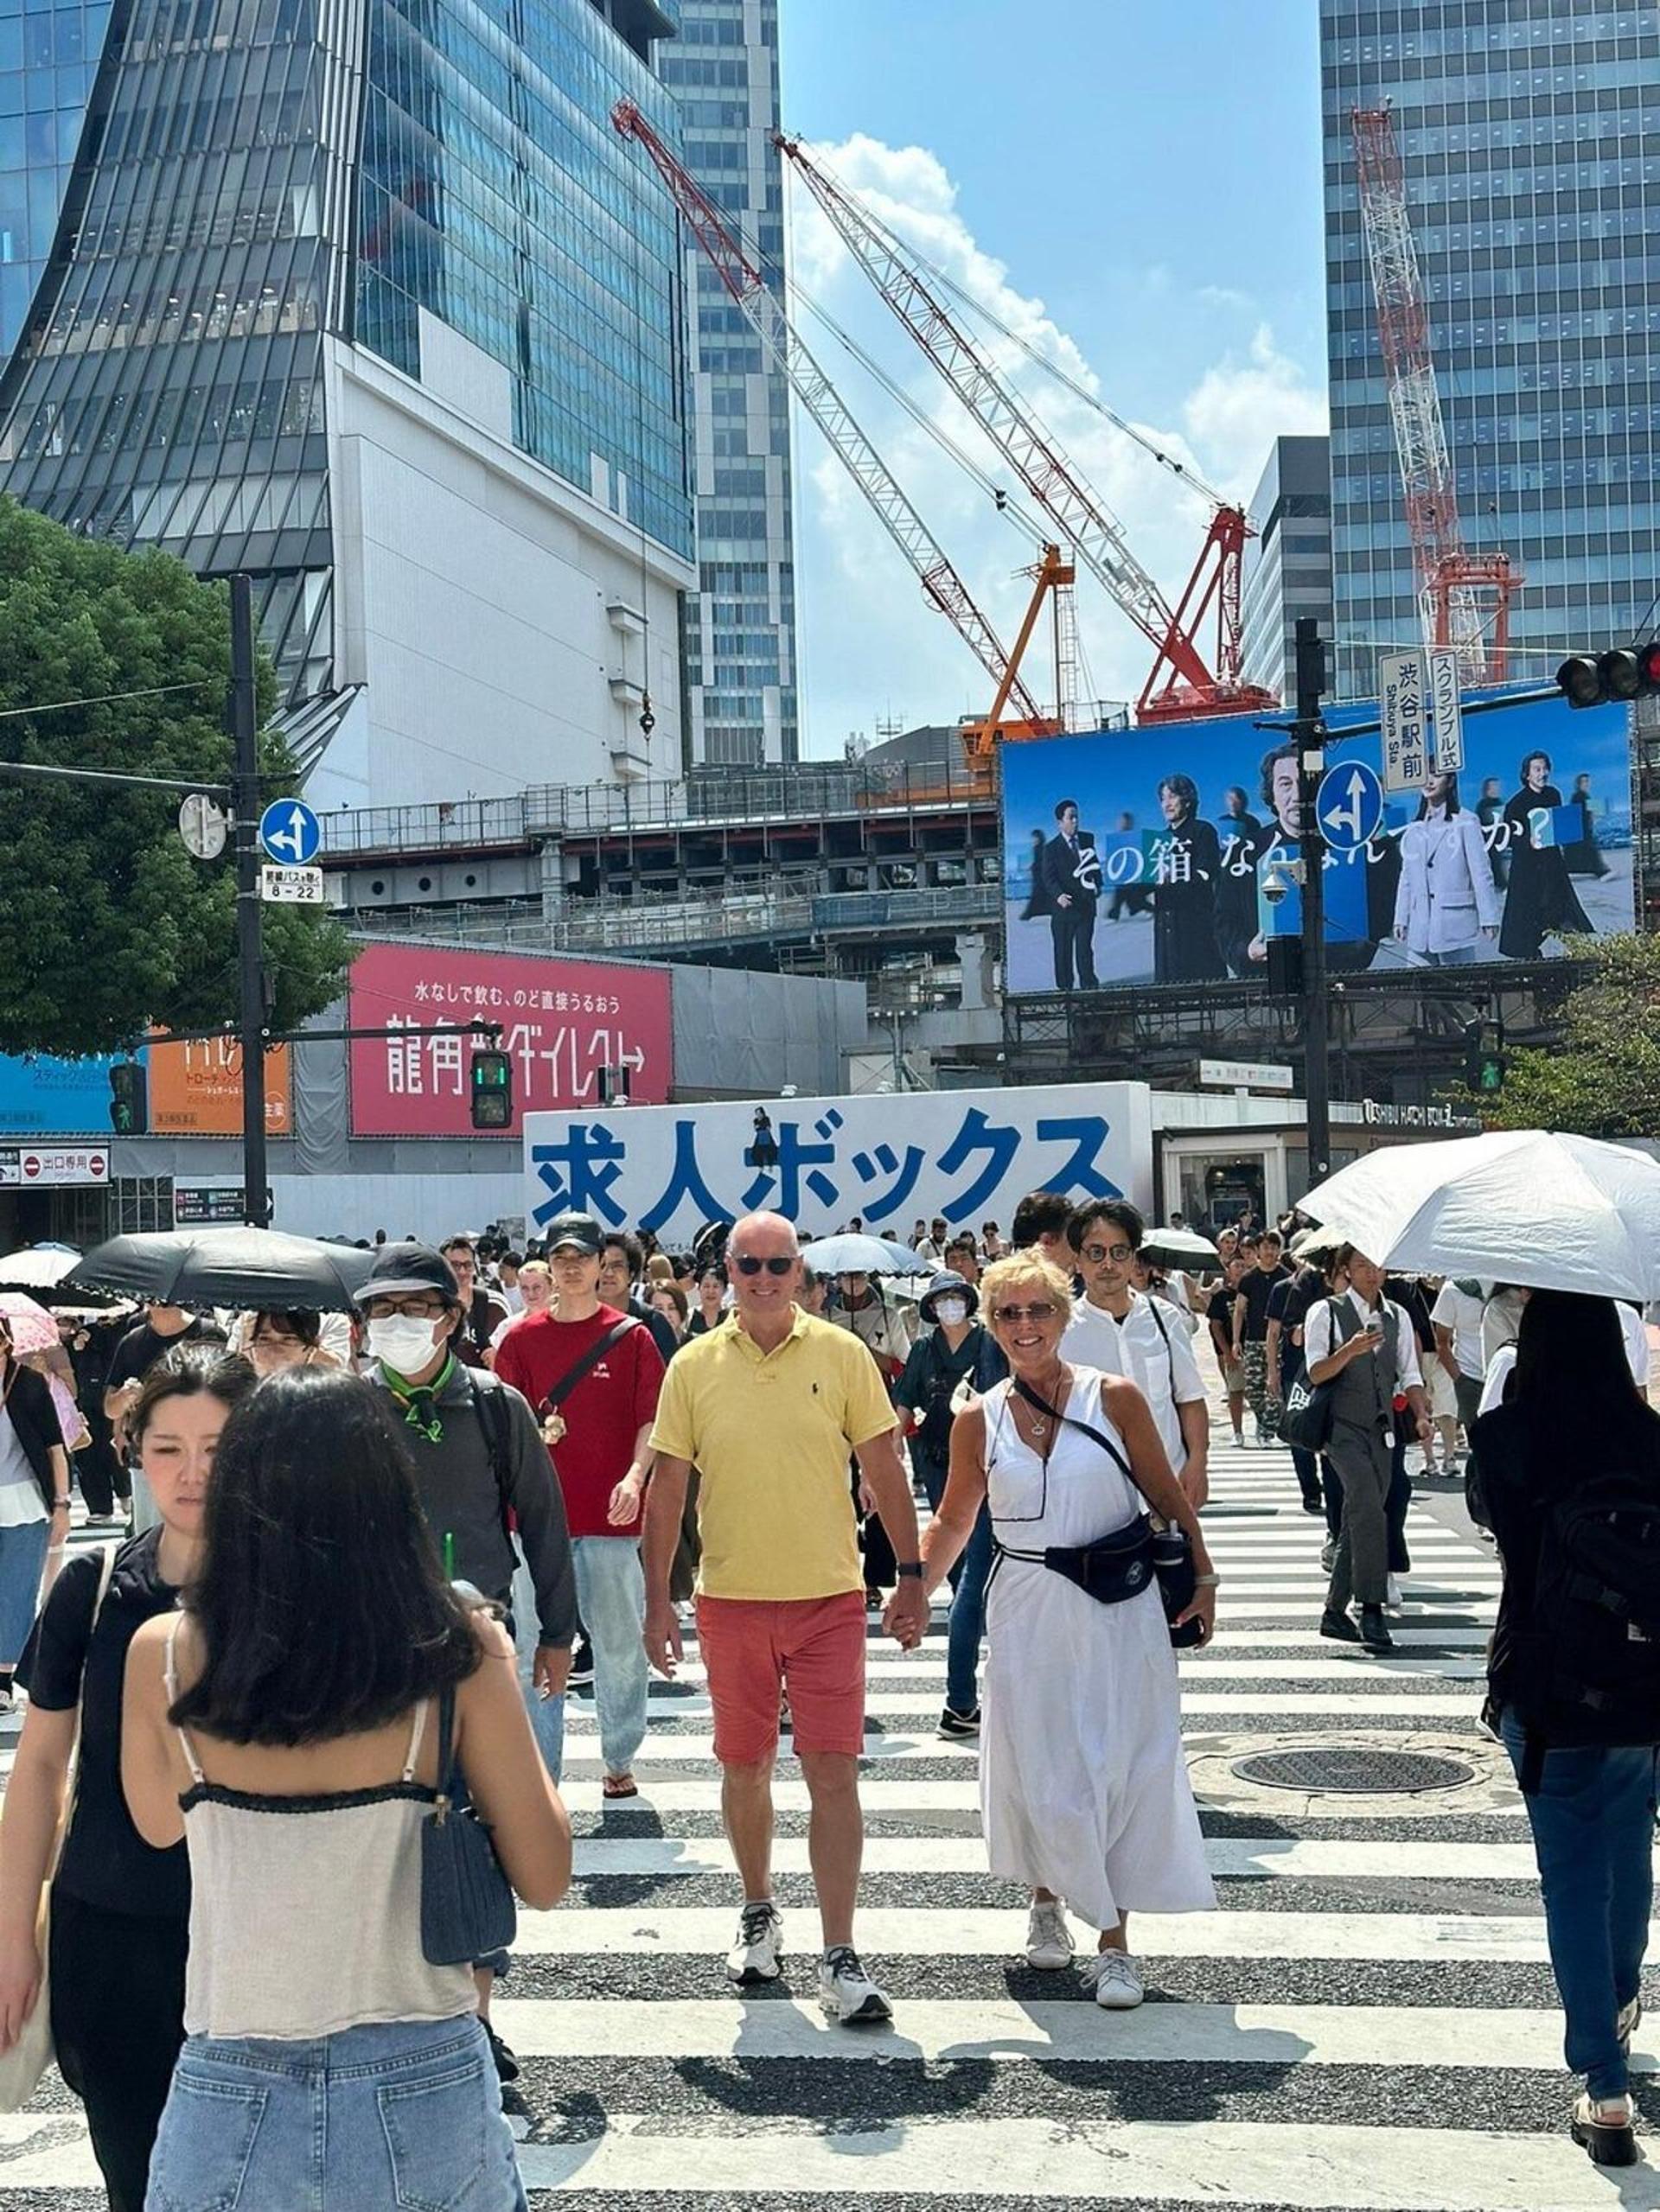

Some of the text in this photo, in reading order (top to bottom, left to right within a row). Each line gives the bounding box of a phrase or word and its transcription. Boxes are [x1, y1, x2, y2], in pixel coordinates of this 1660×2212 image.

[1386, 684, 1400, 769] Shibuya Sta.
[1399, 662, 1422, 779] 渋谷駅前
[1436, 658, 1457, 768] スクランブル式
[414, 980, 621, 1015] 水なしで飲む、のど直接うるおう
[531, 1106, 1125, 1232] 求人ボックス
